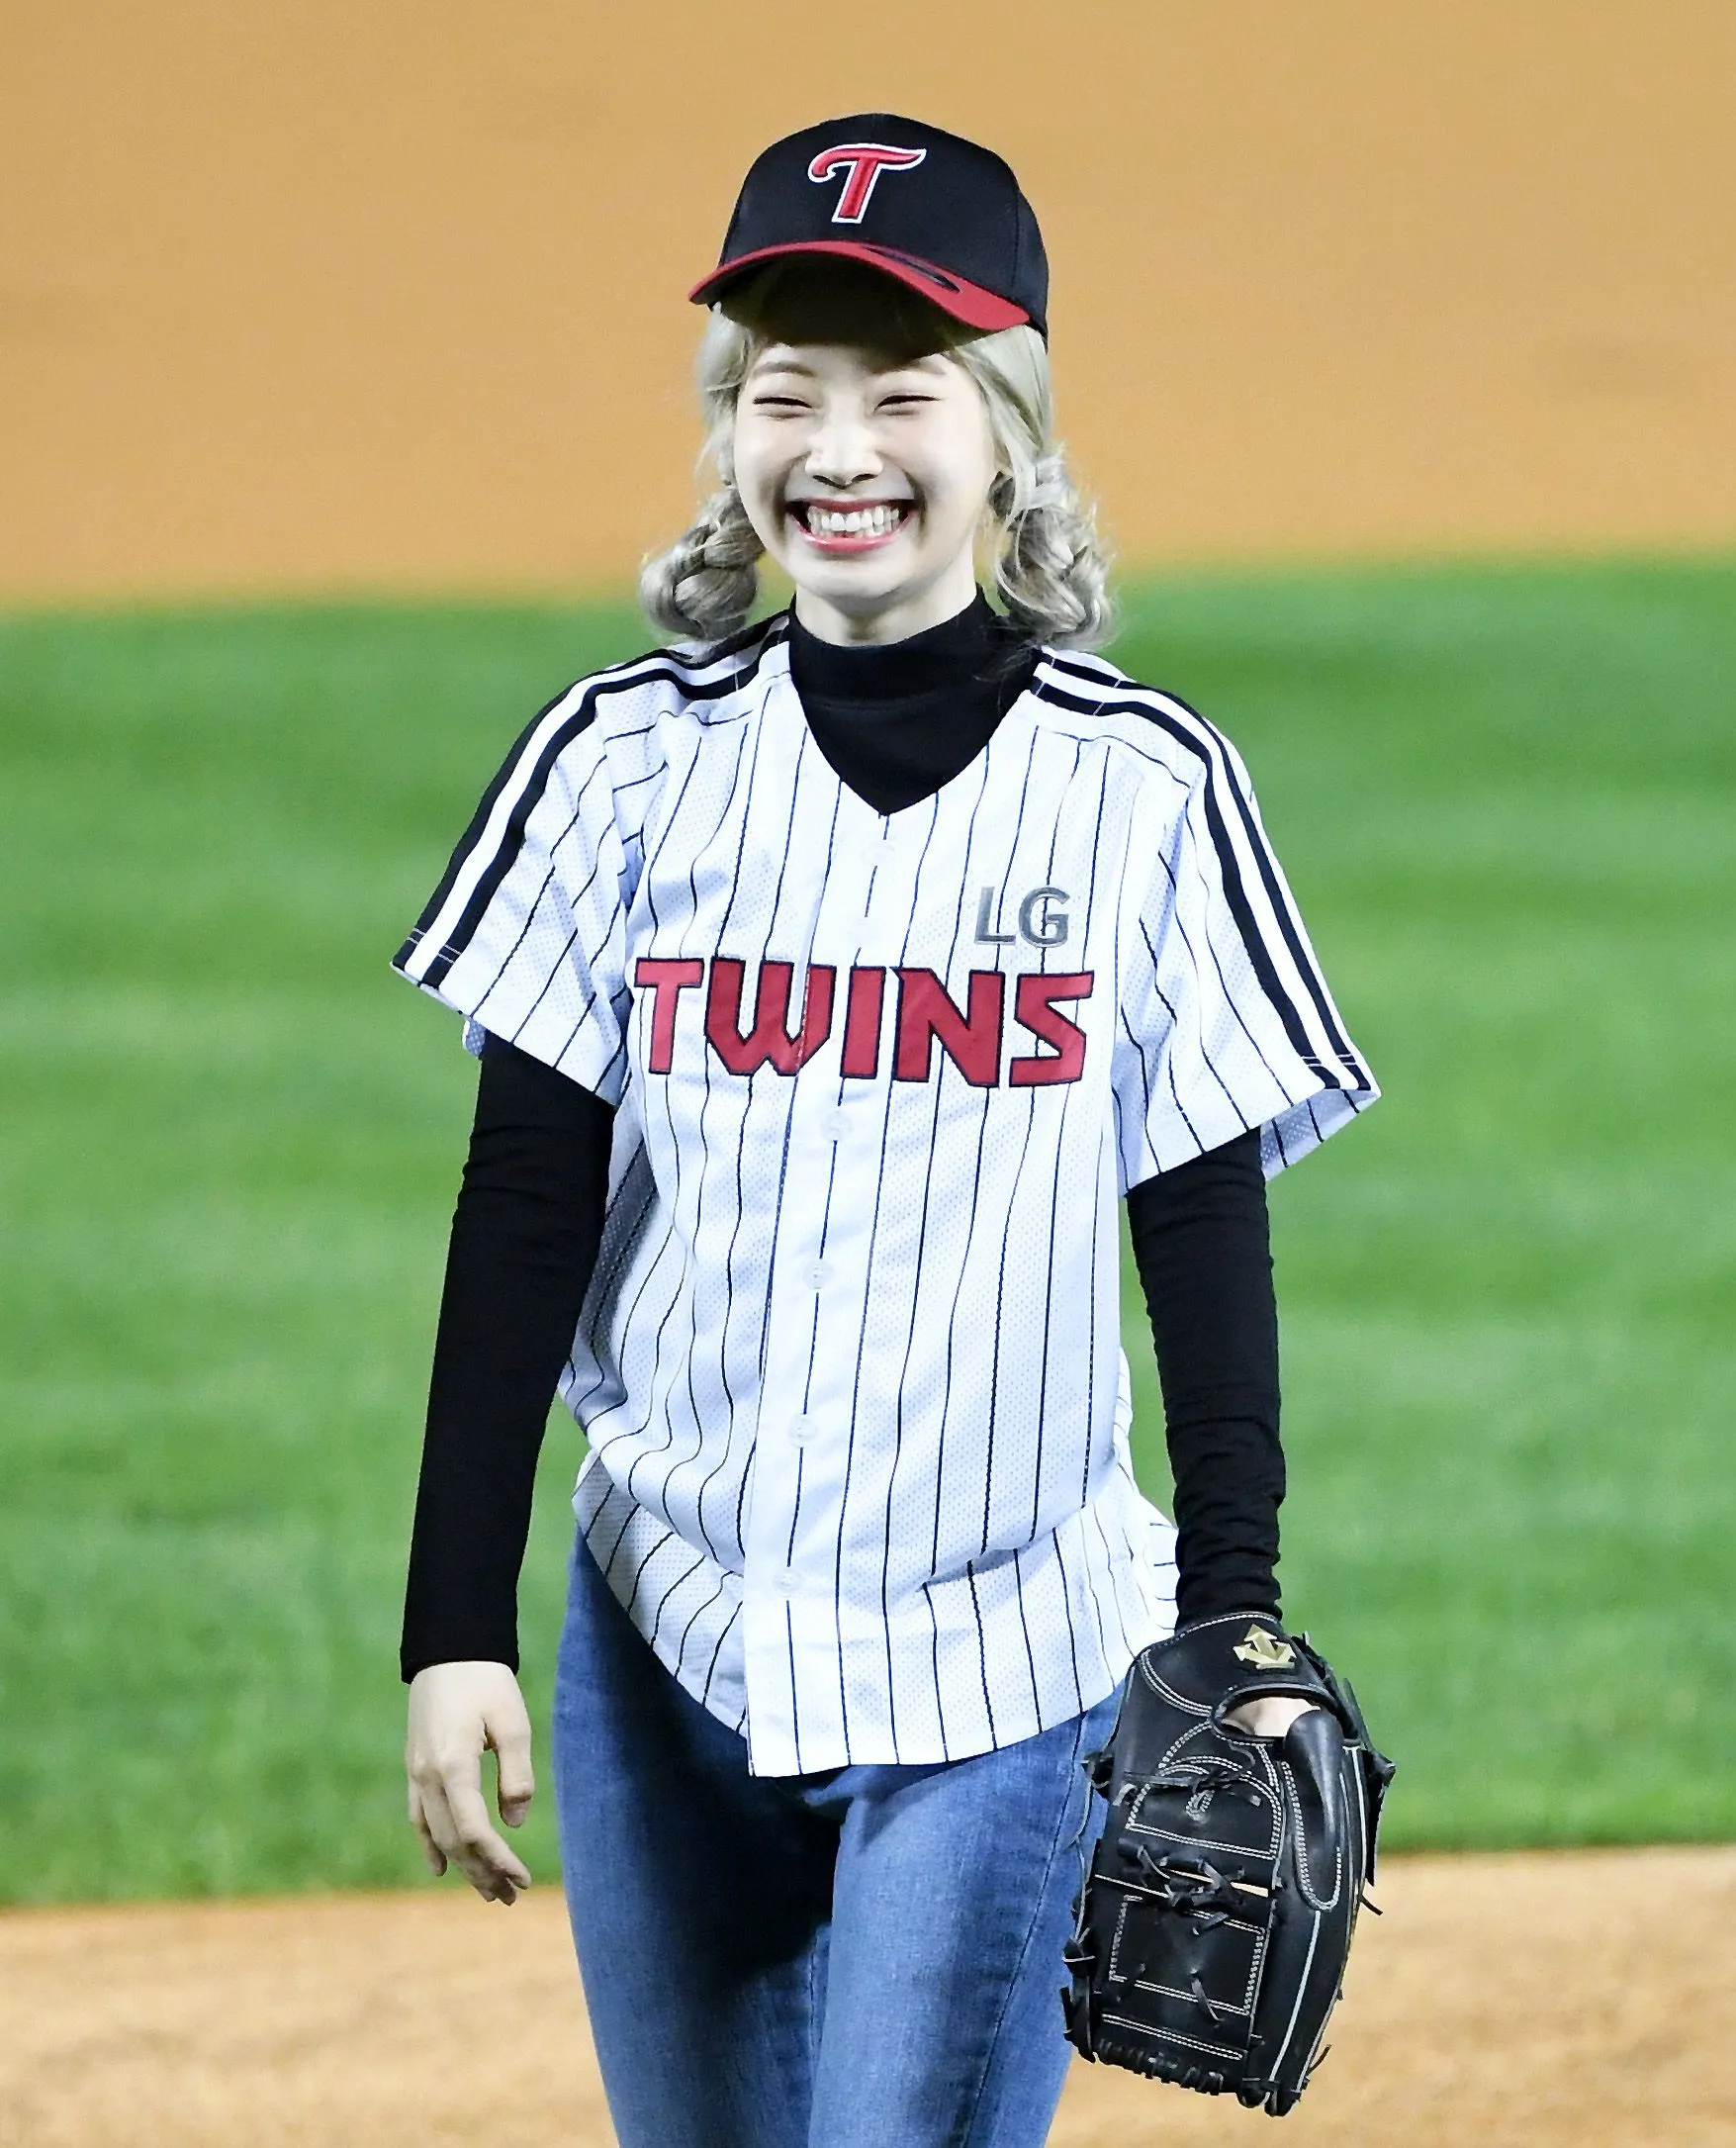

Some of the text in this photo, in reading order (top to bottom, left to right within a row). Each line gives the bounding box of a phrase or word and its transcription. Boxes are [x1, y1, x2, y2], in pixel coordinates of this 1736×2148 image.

[808, 143, 927, 224] T
[974, 887, 1069, 947] LG
[634, 956, 1094, 1088] TWINS
